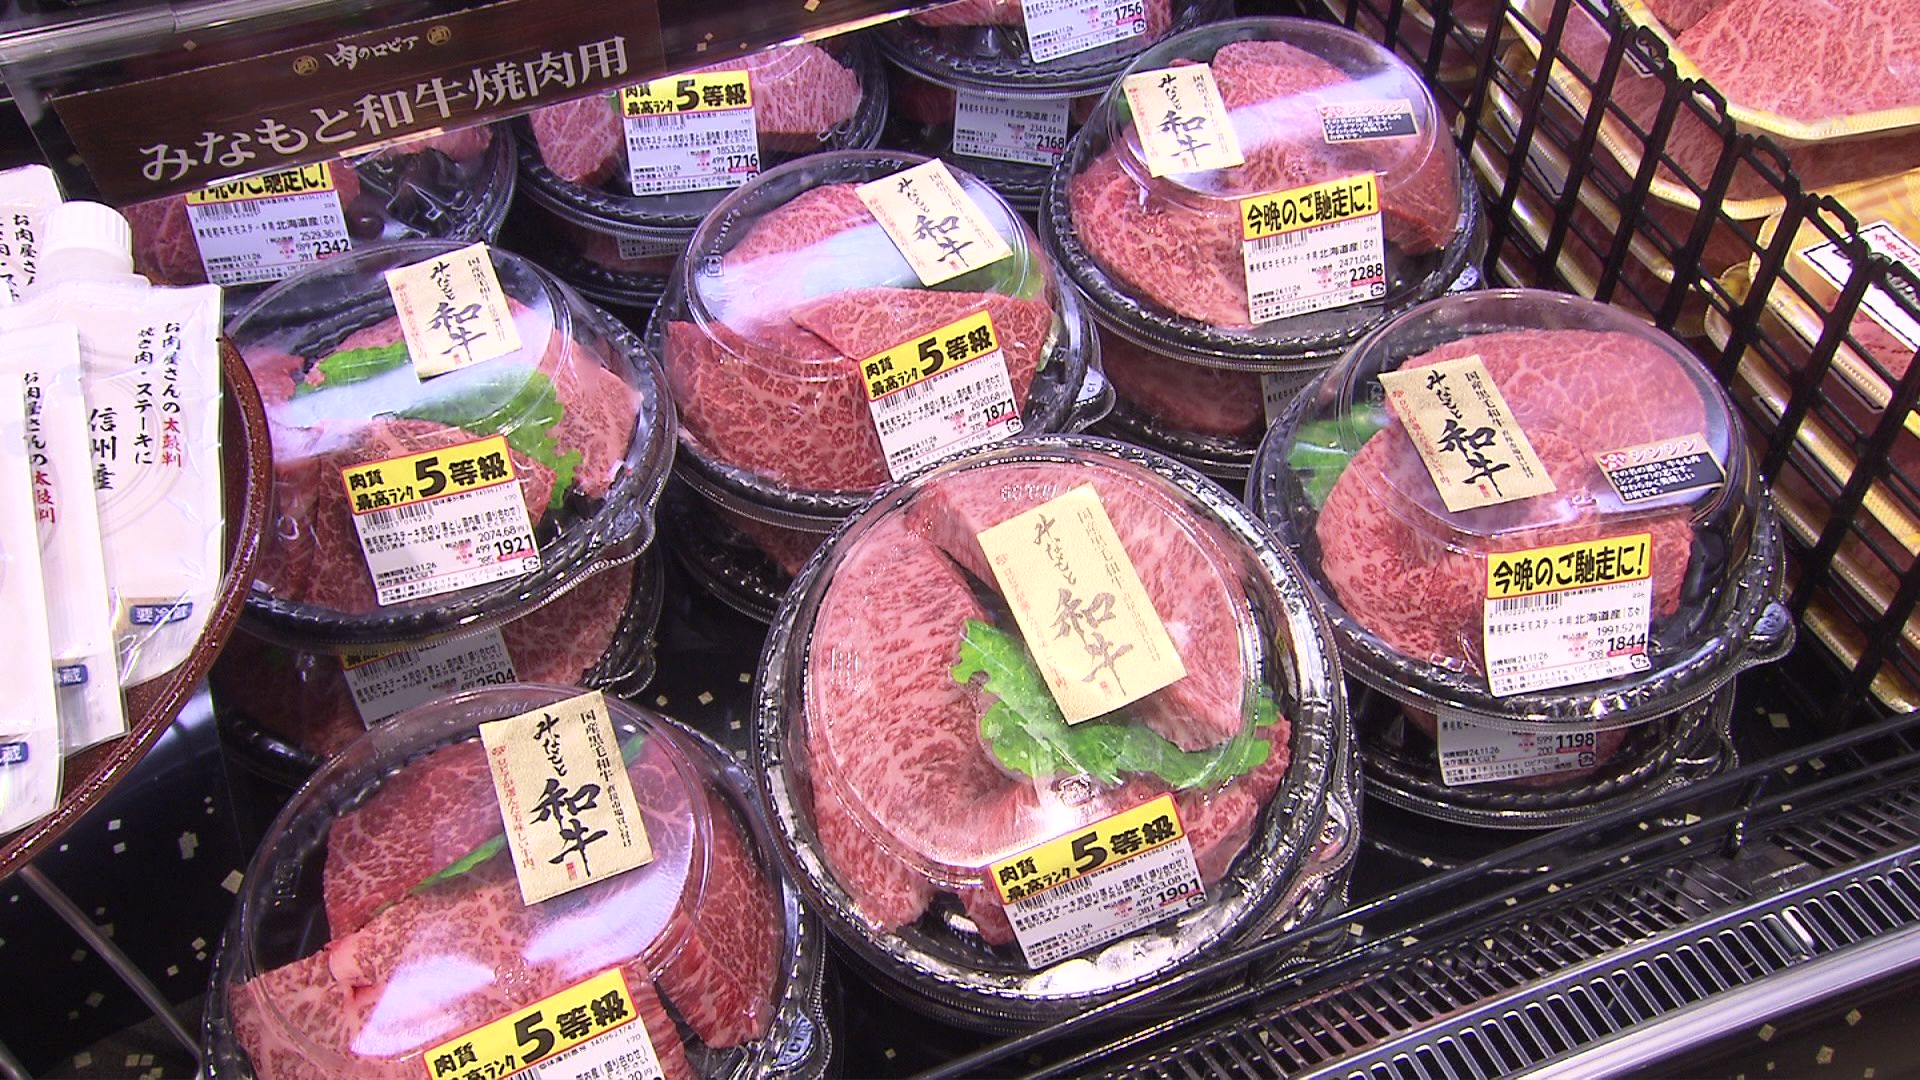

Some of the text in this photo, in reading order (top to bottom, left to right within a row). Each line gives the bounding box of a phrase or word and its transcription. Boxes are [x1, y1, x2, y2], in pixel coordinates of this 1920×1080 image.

[1113, 2, 1144, 20] 1756
[325, 36, 419, 70] 肉のロピア
[628, 100, 673, 115] 最高ランク
[676, 79, 747, 111] 5等級
[139, 36, 627, 181] みなもと和牛焼肉用
[1037, 134, 1065, 150] 2168
[726, 154, 758, 168] 1716
[1248, 181, 1372, 235] 今晩のご馳走に!
[312, 239, 351, 257] 2342
[1349, 263, 1384, 282] 2288
[918, 325, 993, 376] 5等級
[865, 356, 894, 379] 肉質
[871, 367, 918, 398] 最高ランク
[983, 398, 1016, 422] 1871
[89, 406, 118, 490] 信州産
[350, 468, 383, 491] 肉質
[415, 452, 508, 498] 5等級
[356, 485, 413, 511] 最高ランク
[494, 533, 535, 557] 1921
[1493, 546, 1645, 595] 今晩のご馳走に!
[1607, 633, 1646, 651] 1844
[476, 667, 516, 687] 2504
[1555, 732, 1595, 749] 1198
[529, 712, 608, 877] みなもと和牛
[1072, 815, 1176, 874] 5等級
[999, 857, 1037, 885] 肉質
[1007, 867, 1071, 900] 最高ランク
[1139, 871, 1197, 897] 2053.08円)
[1156, 879, 1201, 904] 1901
[514, 990, 628, 1064] 5等級
[434, 1043, 478, 1077] 肉質
